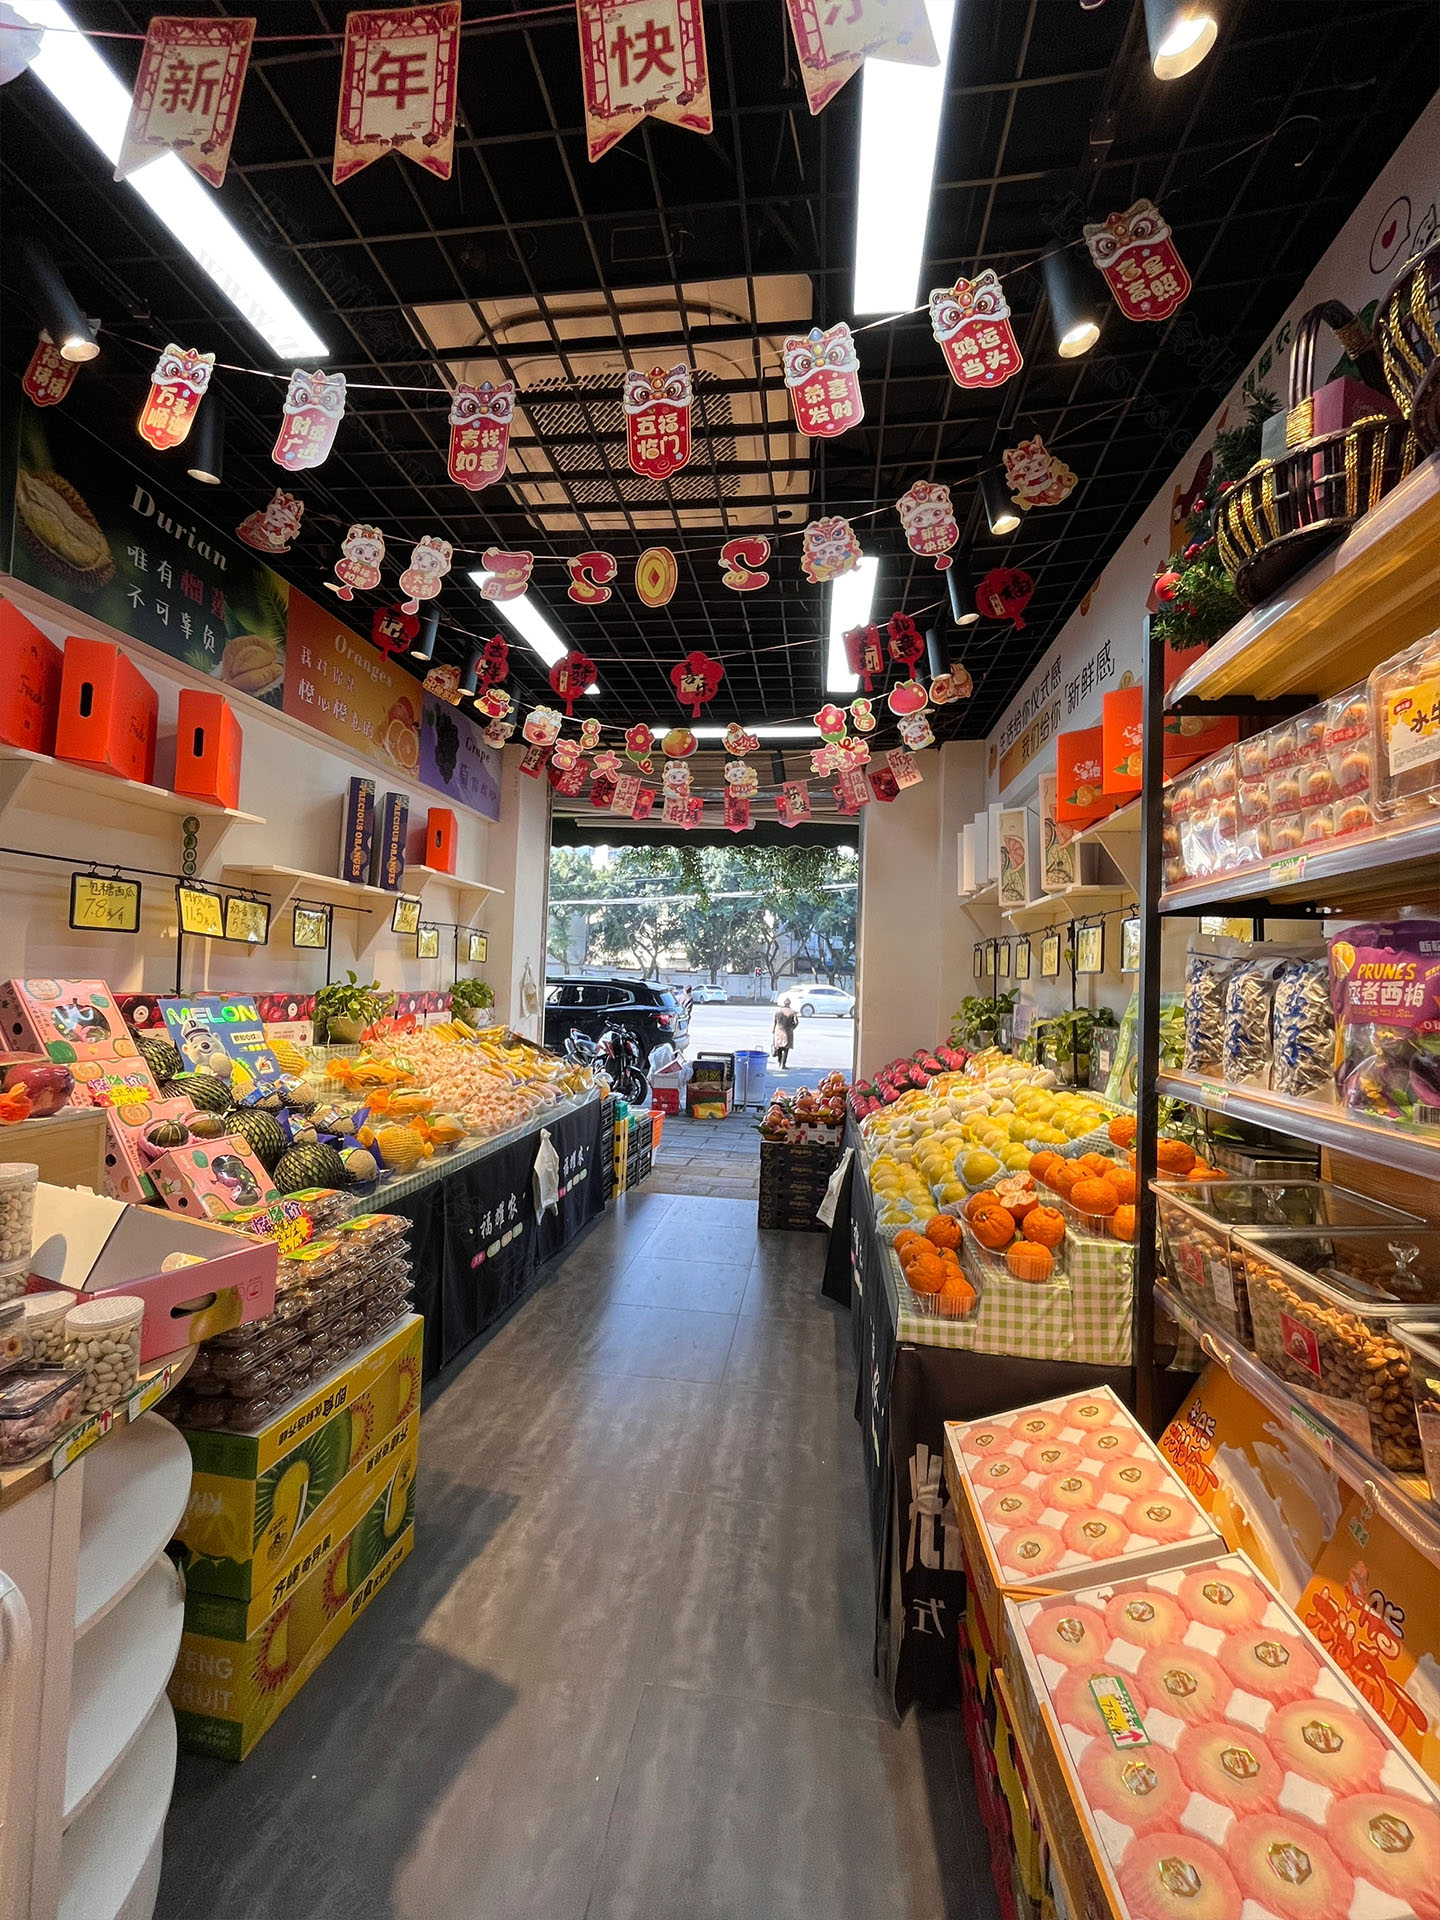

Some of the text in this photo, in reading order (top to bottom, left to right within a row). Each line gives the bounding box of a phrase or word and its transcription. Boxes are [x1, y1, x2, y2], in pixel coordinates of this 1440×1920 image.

[160, 20, 675, 115] 新 年 快
[951, 327, 1001, 360] 鸿运
[962, 351, 1010, 379] 当头
[157, 386, 190, 415] 万事
[804, 378, 849, 403] 恭喜
[636, 412, 679, 435] 五福
[808, 398, 853, 425] 发财
[460, 428, 500, 449] 吉祥
[637, 435, 680, 460] 临门
[455, 450, 499, 472] 如意
[130, 485, 228, 571] Durian
[923, 538, 951, 553] 快乐
[127, 583, 216, 654] 不可辜负
[334, 635, 392, 687] Oranges
[1021, 700, 1062, 763] 我们给你
[465, 736, 491, 763] Grape
[353, 786, 366, 877] PRECIOUS ORANGES
[388, 801, 401, 885] PRECIOUS ORANGES
[1357, 963, 1417, 981] PRUNES
[166, 1005, 258, 1025] MELON
[272, 1533, 333, 1607] 齐峰奇异果
